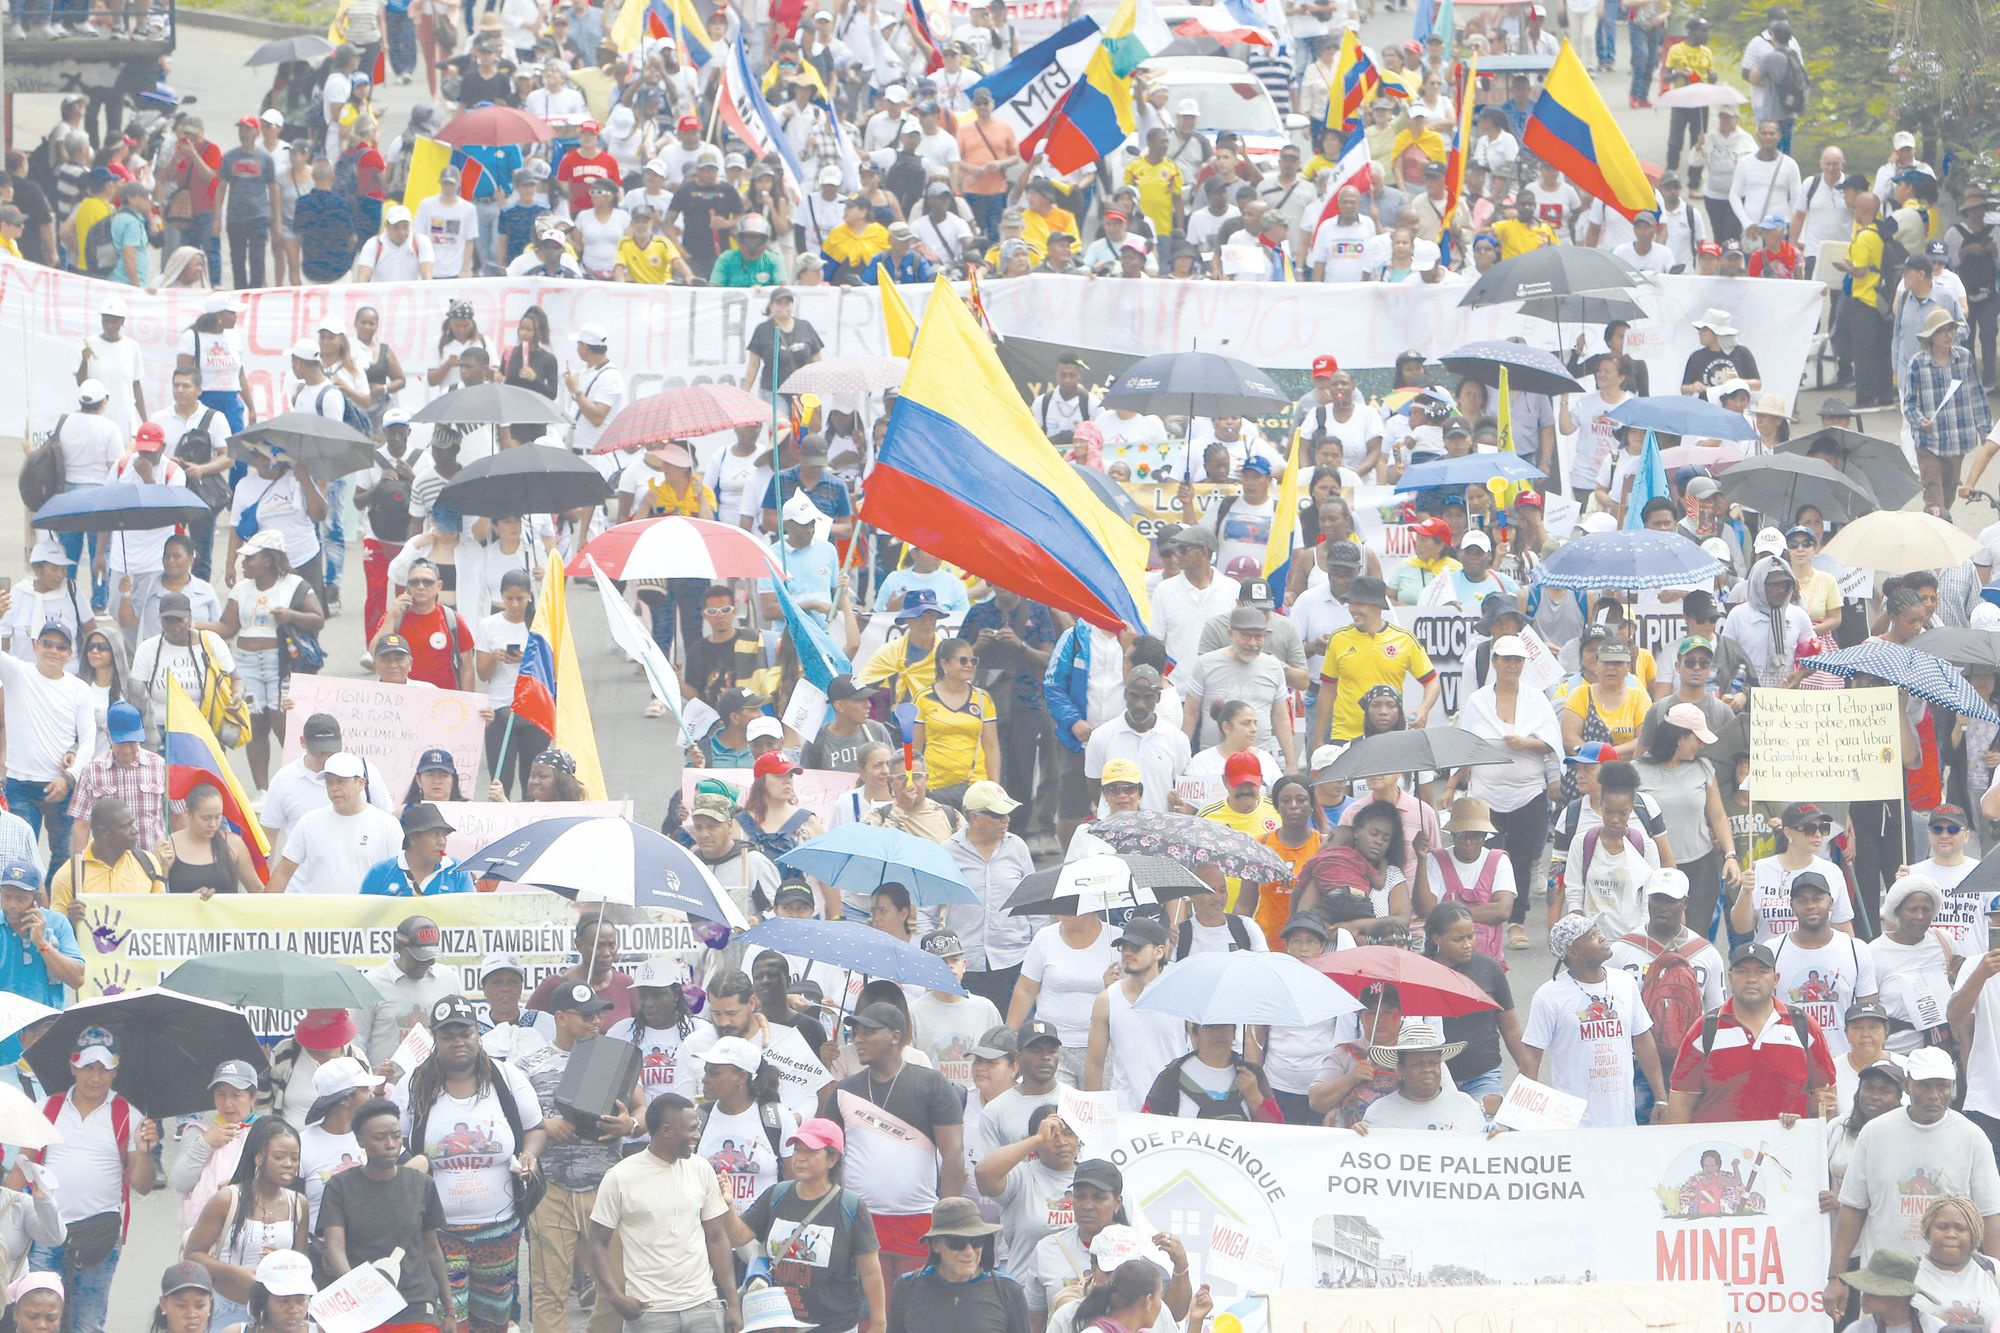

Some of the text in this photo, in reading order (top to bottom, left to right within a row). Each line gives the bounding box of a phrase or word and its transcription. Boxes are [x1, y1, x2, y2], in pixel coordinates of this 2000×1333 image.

[206, 357, 238, 368] MINGA
[1591, 424, 1614, 438] MING
[1386, 527, 1418, 556] MIN
[1753, 694, 1893, 719] Nadie voto por Petro para
[1780, 716, 1791, 729] de
[1795, 719, 1810, 730] ser
[1815, 717, 1847, 734] pobre,
[1849, 715, 1887, 729] muchos
[1797, 739, 1811, 756] por
[1835, 739, 1860, 755] para
[1862, 731, 1894, 746] librar
[1751, 748, 1879, 765] a Colombia de las ratas
[1751, 764, 1851, 785] que la gobernaban
[1731, 813, 1765, 826] TEGO
[1732, 822, 1774, 835] AURUS
[1593, 878, 1619, 889] WORTH
[1763, 908, 1795, 919] El Futu
[1932, 911, 1975, 924] uturo De
[1963, 902, 1978, 914] Por
[128, 930, 270, 957] ASENTAMIENTO
[304, 930, 365, 956] NUEVA
[483, 923, 564, 954] TAMBIÉN
[612, 924, 698, 951] OLOMBIA.
[1803, 1005, 1836, 1028] NGA
[1916, 995, 1941, 1026] MINGA
[1579, 1020, 1625, 1041] MINGA
[762, 1048, 824, 1077] ¿Dónde está la
[940, 1061, 973, 1081] MING
[779, 1071, 808, 1087] RRA??
[1063, 1092, 1096, 1126] MINGA
[1509, 1082, 1551, 1117] MINGA
[434, 1156, 495, 1171] MINGA
[1131, 1133, 1164, 1162] DE
[1169, 1130, 1287, 1205] PALENQUE
[1340, 1151, 1573, 1176] ASO DE PALENQUE
[1328, 1175, 1585, 1201] POR VIVIENDA DIGNA
[1047, 1210, 1074, 1225] MIN
[1211, 1223, 1251, 1262] MINGA
[1656, 1225, 1786, 1286] MINGA
[313, 1286, 361, 1322] MINGA
[1728, 1291, 1825, 1314] TODOS
